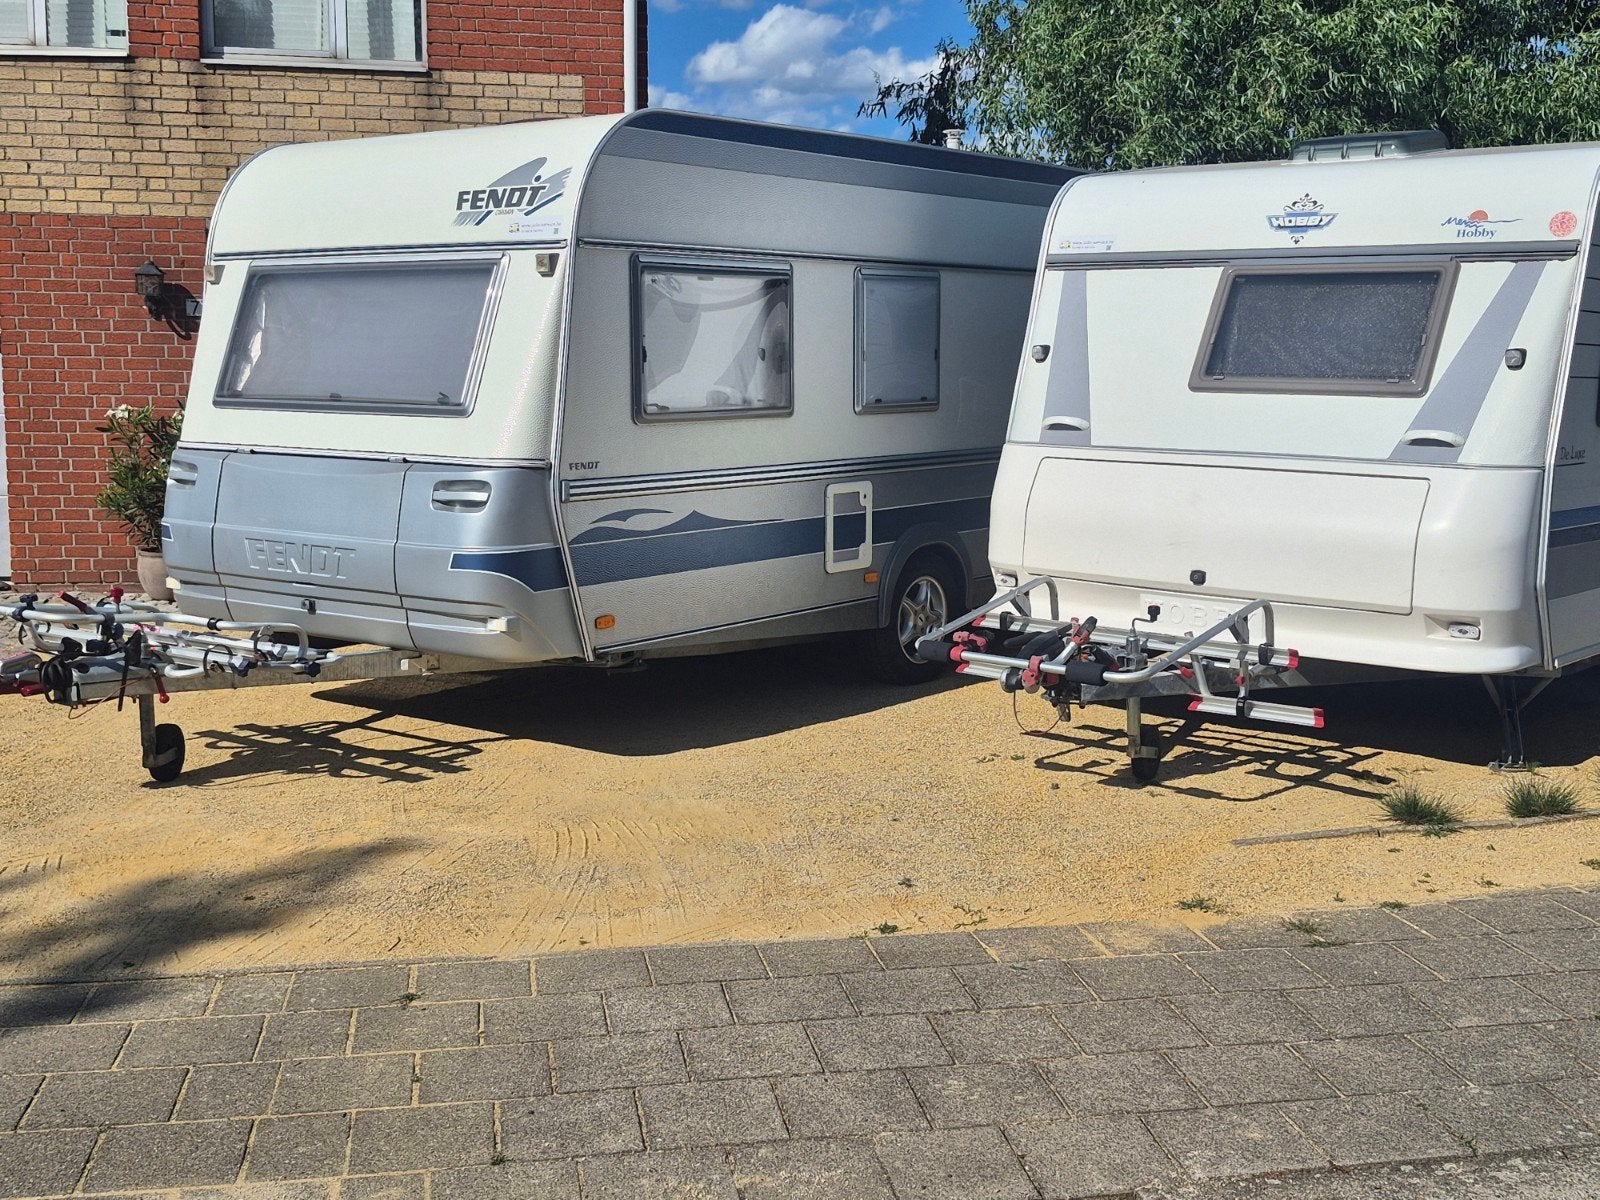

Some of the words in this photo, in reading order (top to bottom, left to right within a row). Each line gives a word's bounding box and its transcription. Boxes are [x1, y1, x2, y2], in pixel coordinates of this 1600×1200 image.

[455, 185, 548, 211] FENDT
[1268, 213, 1336, 228] HOBBY
[1456, 227, 1497, 239] Hobby
[190, 300, 200, 316] 7
[568, 460, 600, 471] FENDT
[243, 537, 357, 579] FENDT
